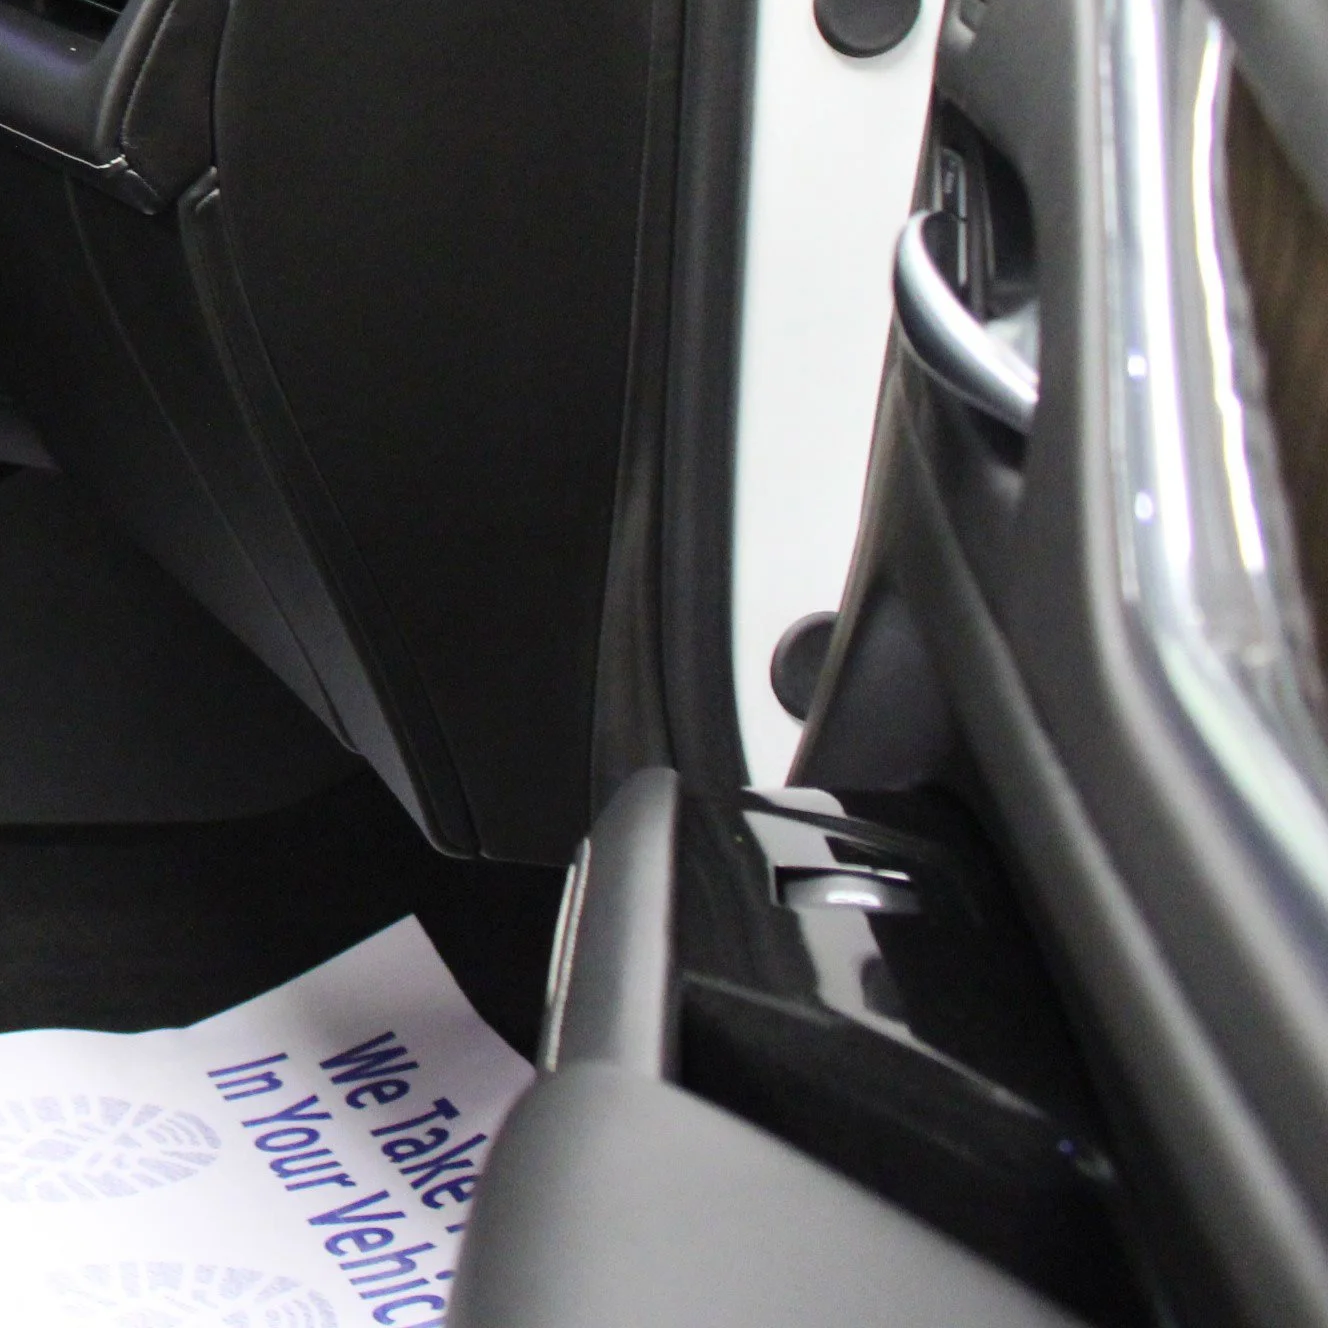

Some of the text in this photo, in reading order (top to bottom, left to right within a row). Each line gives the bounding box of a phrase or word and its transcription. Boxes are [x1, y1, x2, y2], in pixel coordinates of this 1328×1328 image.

[207, 1052, 289, 1102] In
[319, 1030, 488, 1210] We Take
[241, 1094, 357, 1192] Your
